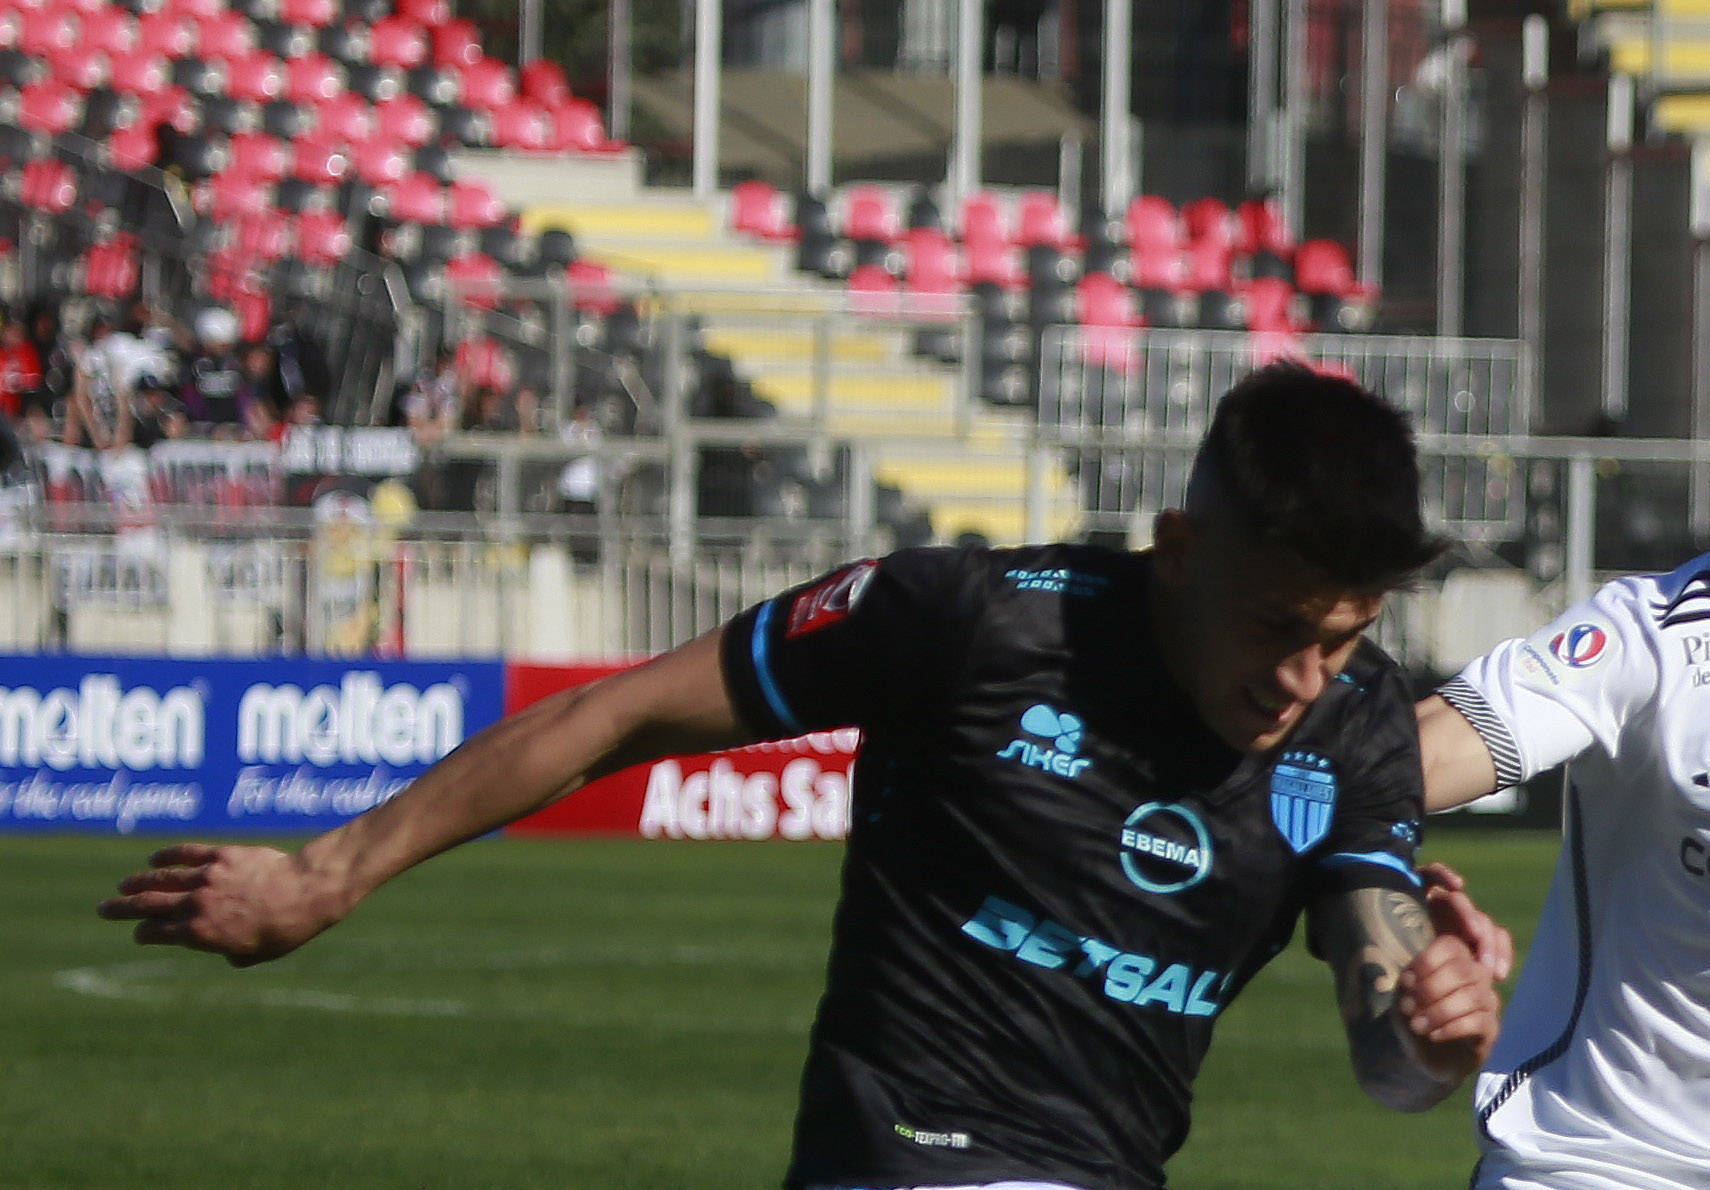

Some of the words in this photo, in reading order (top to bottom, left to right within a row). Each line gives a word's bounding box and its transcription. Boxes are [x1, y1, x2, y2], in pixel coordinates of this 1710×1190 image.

[237, 671, 465, 768] molten
[639, 757, 779, 841] Achs
[778, 757, 855, 841] Sa
[1121, 828, 1201, 869] EBEMA
[960, 895, 1233, 1016] BETSAL
